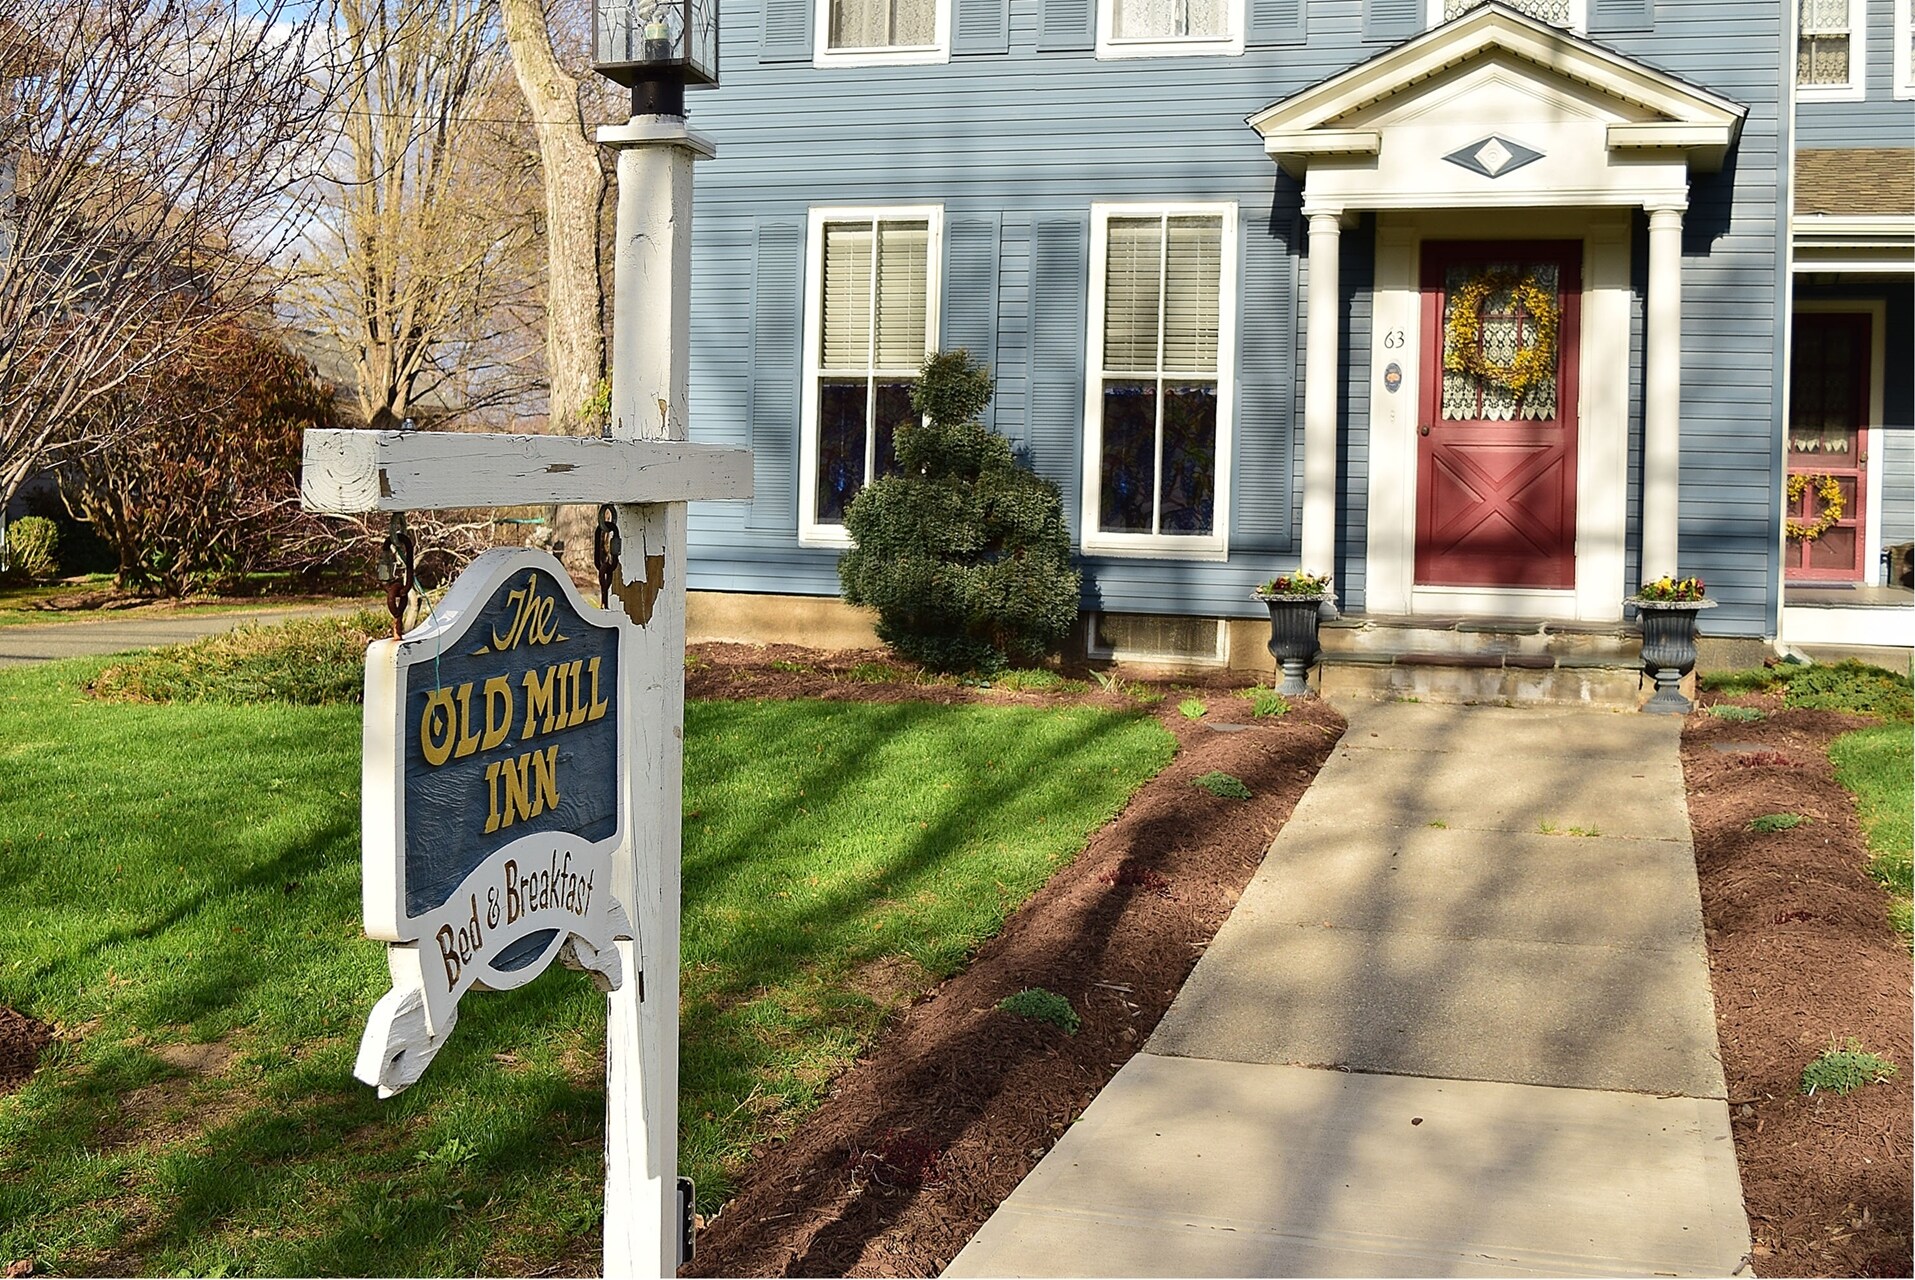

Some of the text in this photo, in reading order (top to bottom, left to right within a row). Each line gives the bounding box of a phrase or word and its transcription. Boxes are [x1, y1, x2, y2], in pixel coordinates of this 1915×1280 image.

[1384, 330, 1405, 350] 63
[492, 572, 560, 651] The
[421, 655, 609, 767] OLD MILL
[484, 743, 560, 835] INN
[436, 849, 596, 993] Bed & Breakfast
